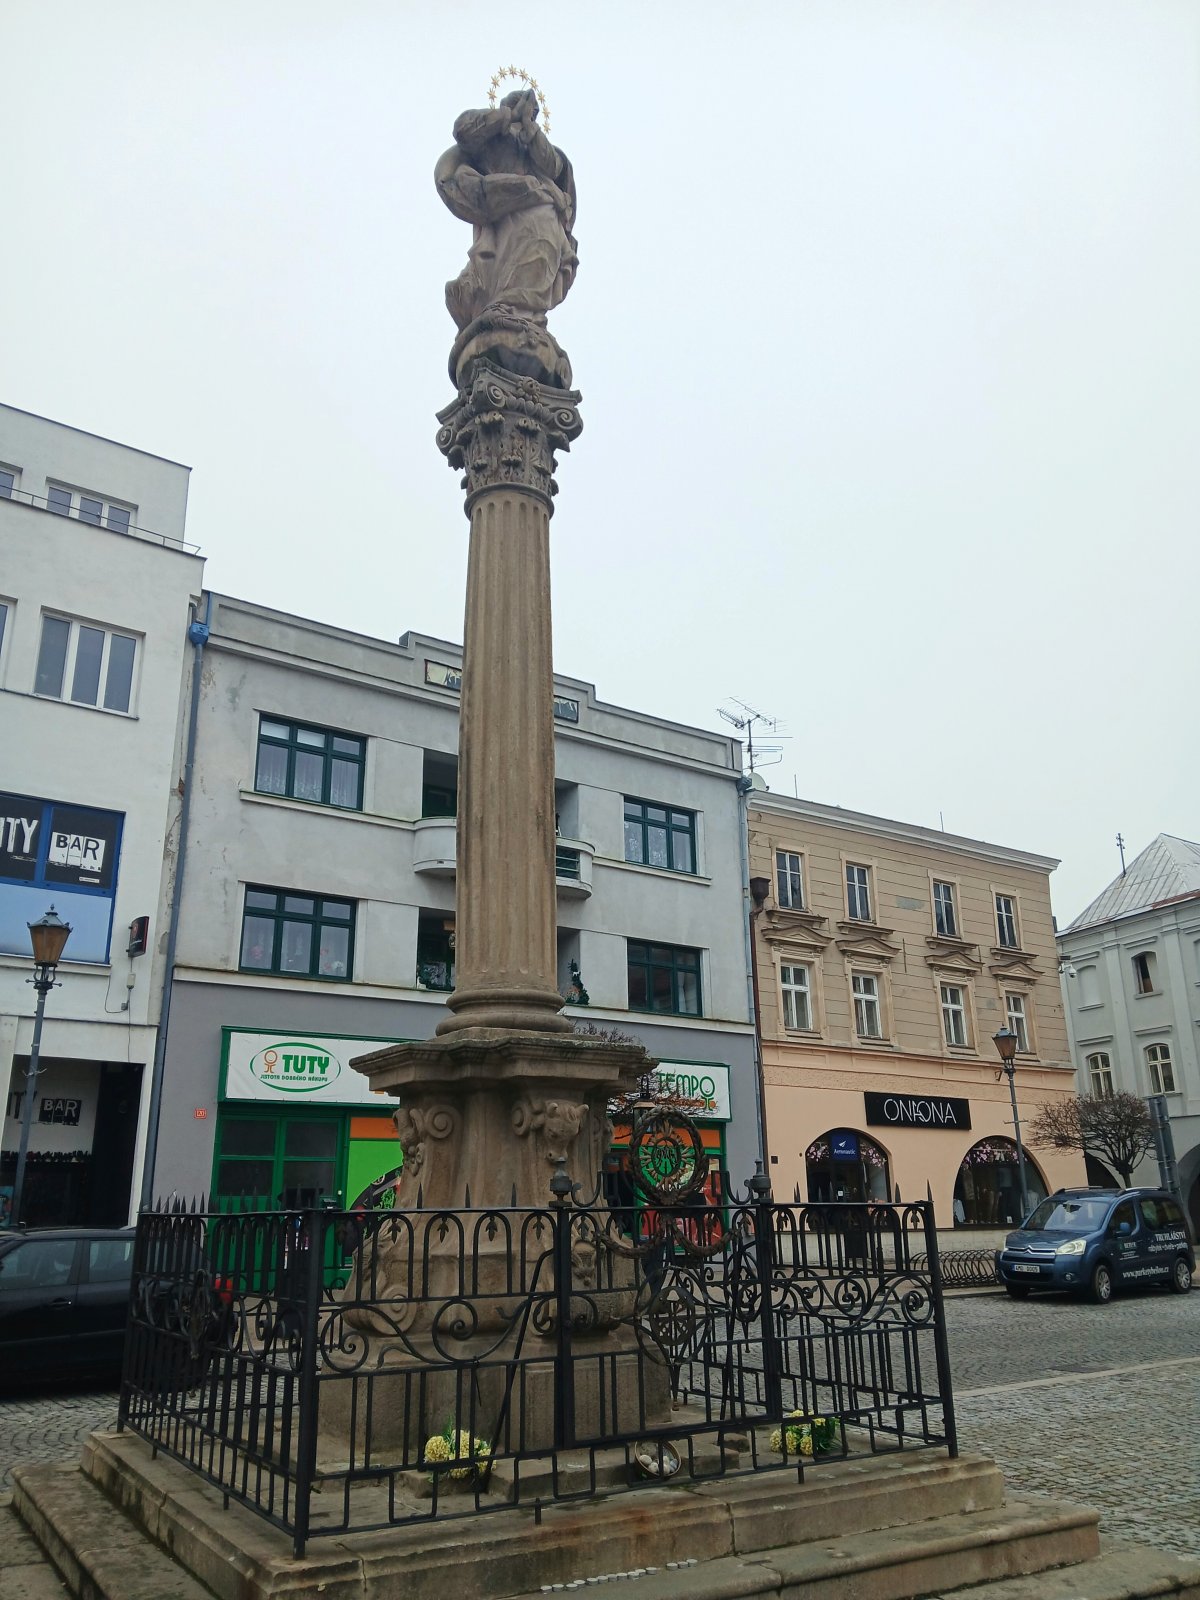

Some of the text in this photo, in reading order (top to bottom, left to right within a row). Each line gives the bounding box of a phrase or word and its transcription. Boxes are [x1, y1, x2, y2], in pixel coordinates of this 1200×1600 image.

[56, 834, 100, 860] BAR
[282, 1054, 329, 1075] TUTY
[656, 1072, 716, 1098] TEMPO
[43, 1099, 78, 1118] BAR
